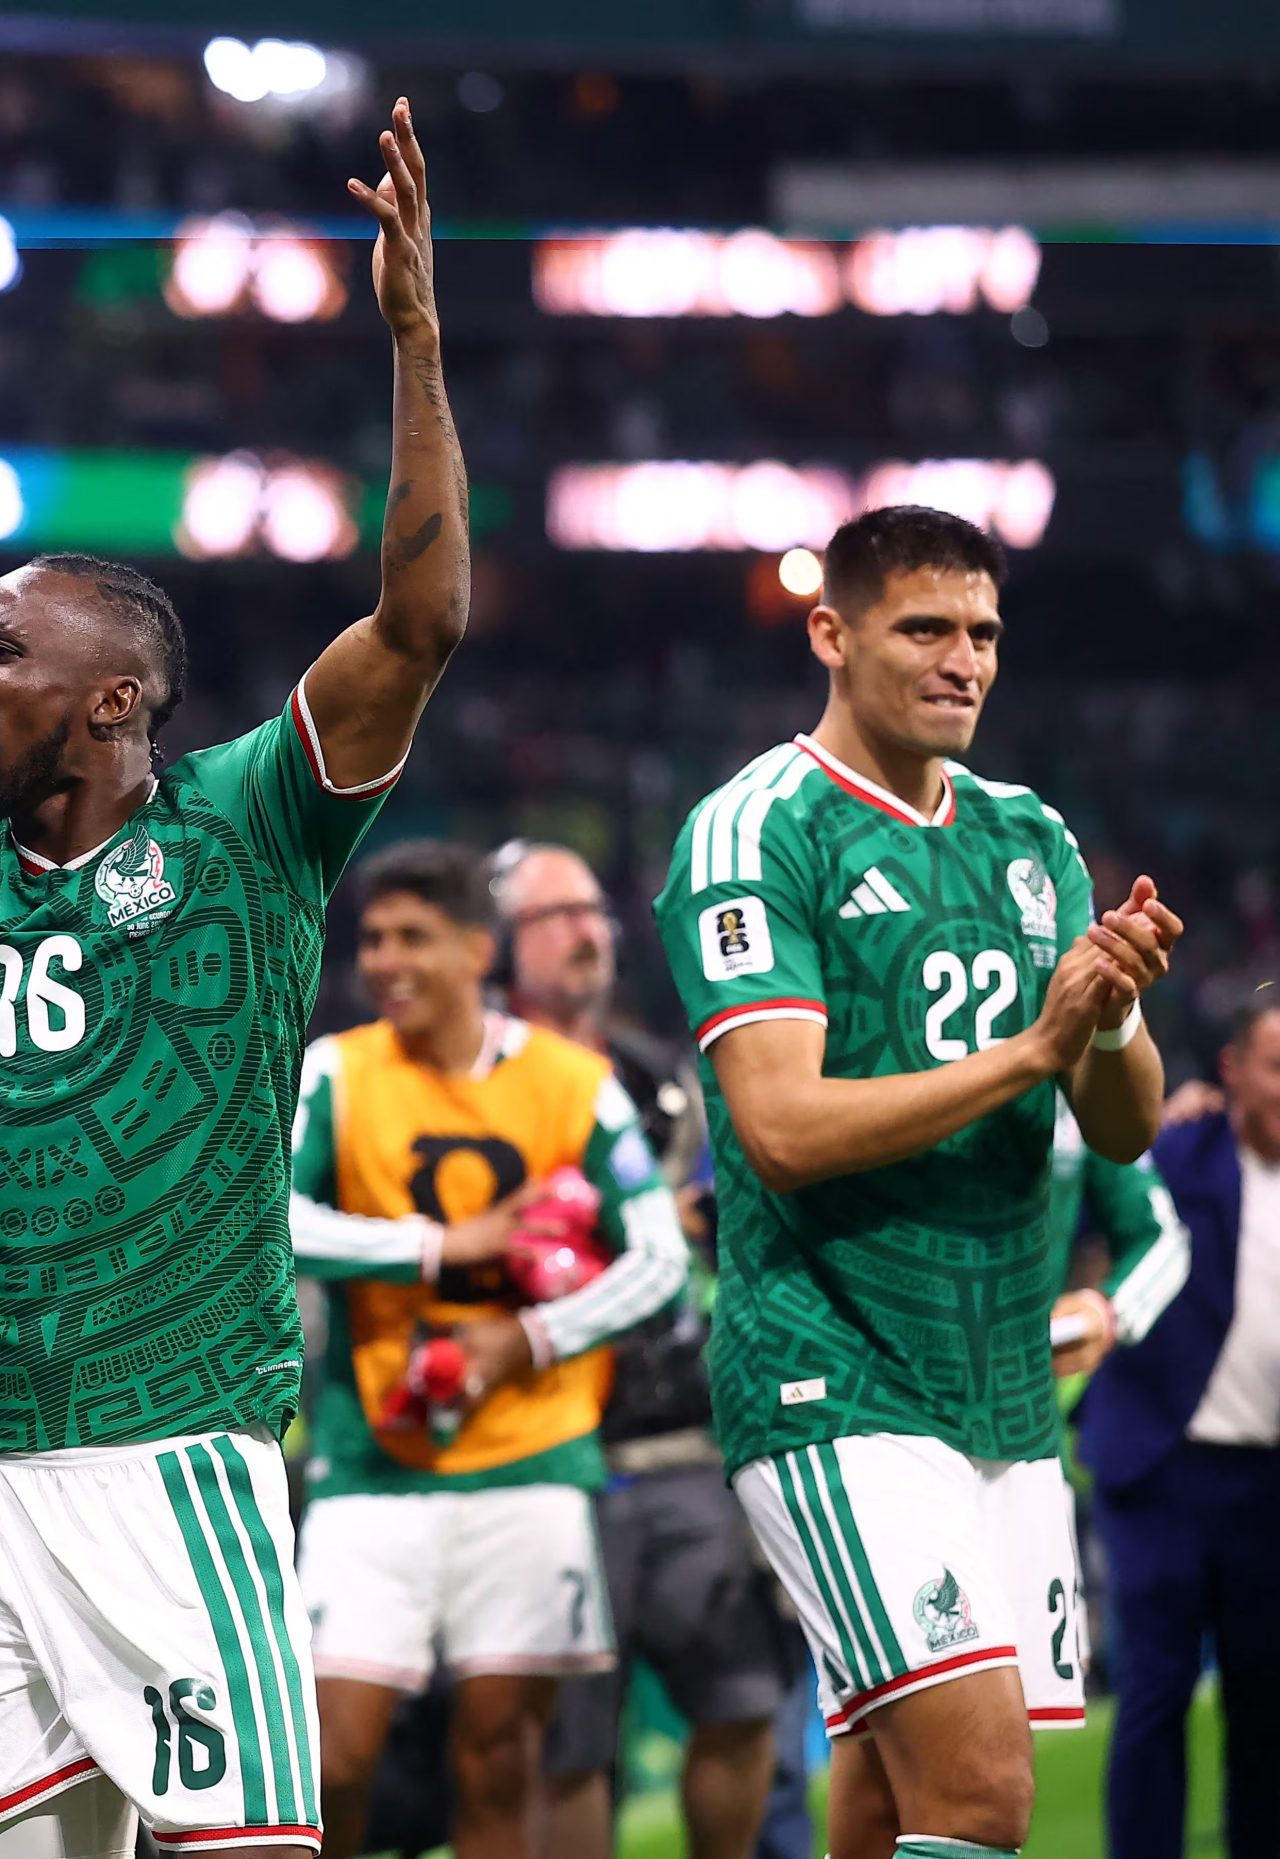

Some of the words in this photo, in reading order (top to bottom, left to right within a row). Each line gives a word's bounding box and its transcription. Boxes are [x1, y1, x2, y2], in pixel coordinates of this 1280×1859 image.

[110, 886, 172, 924] MÉXICO
[923, 948, 1018, 1061] 22
[1048, 1578, 1077, 1680] 2
[144, 1677, 227, 1797] 16
